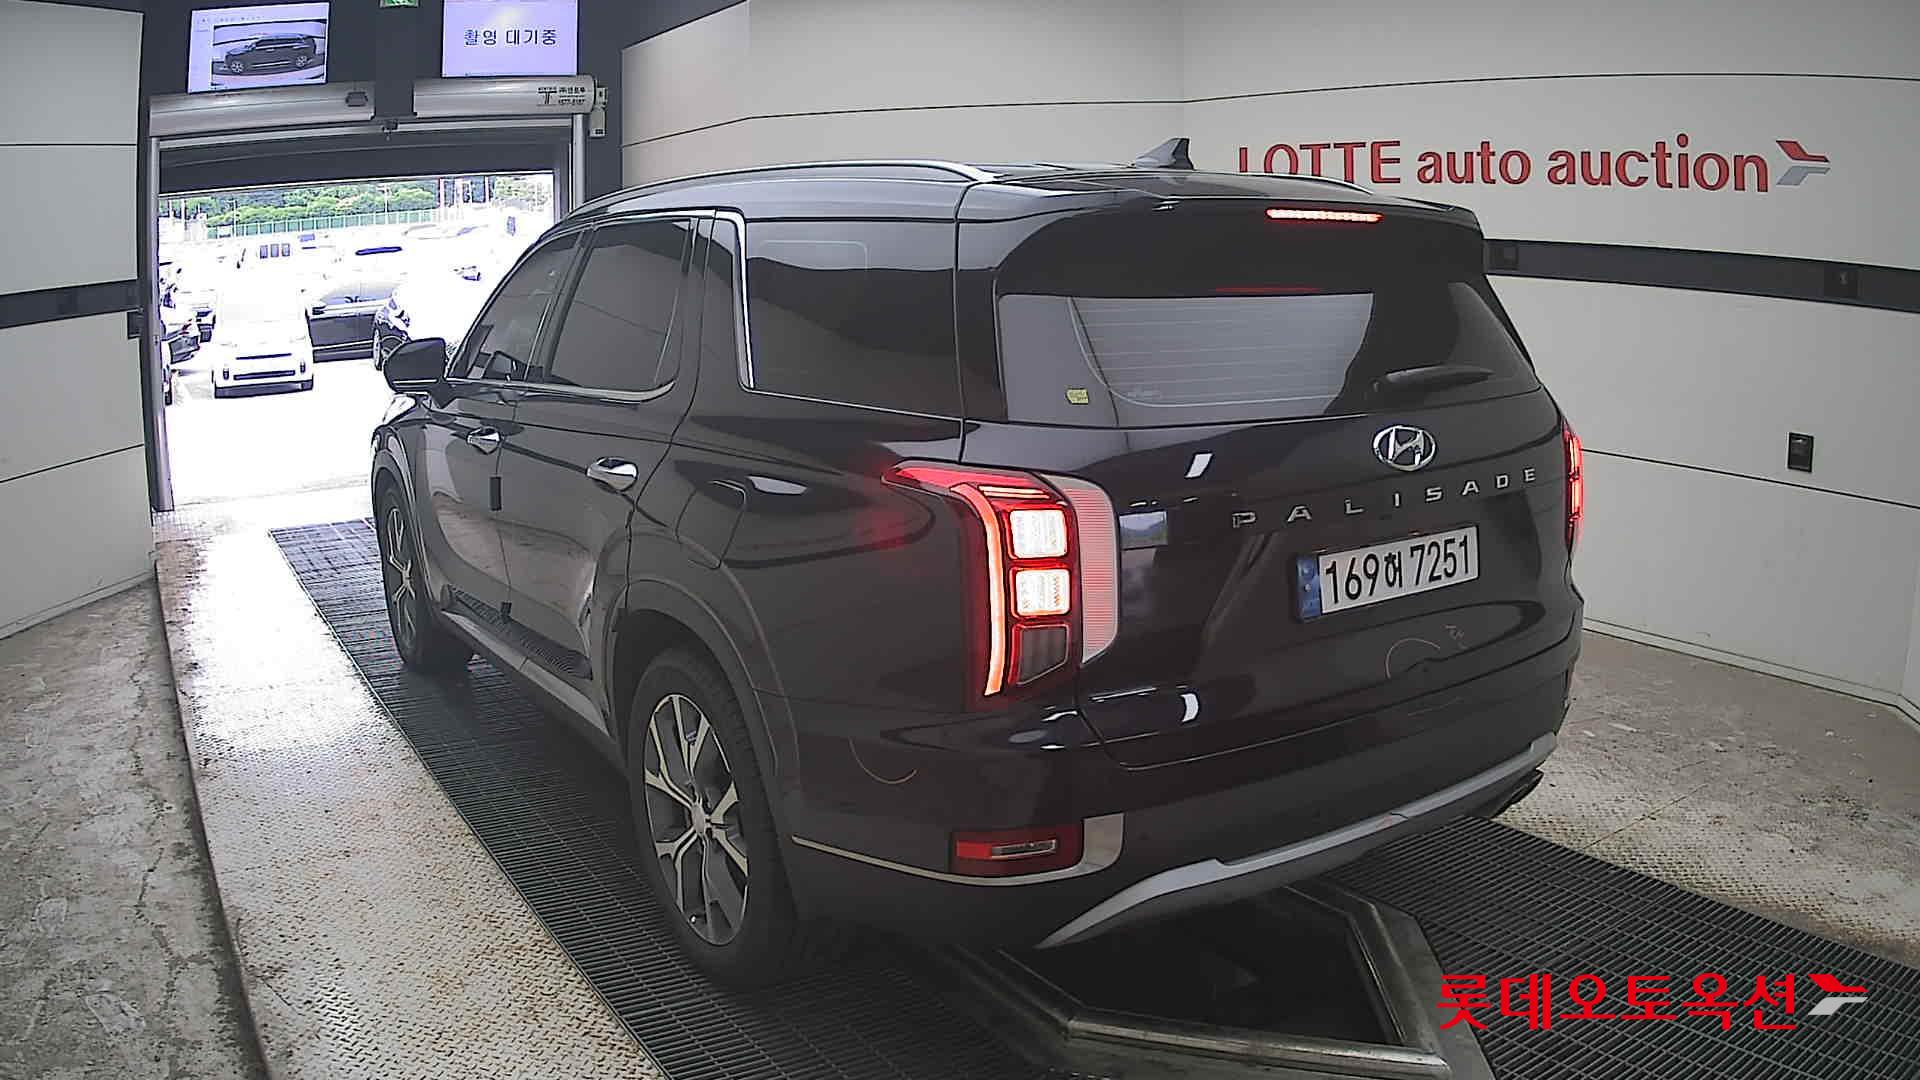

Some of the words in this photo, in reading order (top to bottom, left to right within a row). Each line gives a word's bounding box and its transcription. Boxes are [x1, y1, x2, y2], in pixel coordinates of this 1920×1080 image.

[505, 29, 556, 46] 대기중
[1416, 140, 1532, 184] auto
[1547, 133, 1769, 193] auction
[1231, 467, 1537, 529] PALISADE
[1325, 550, 1404, 605] 169허
[1410, 534, 1469, 587] 7251
